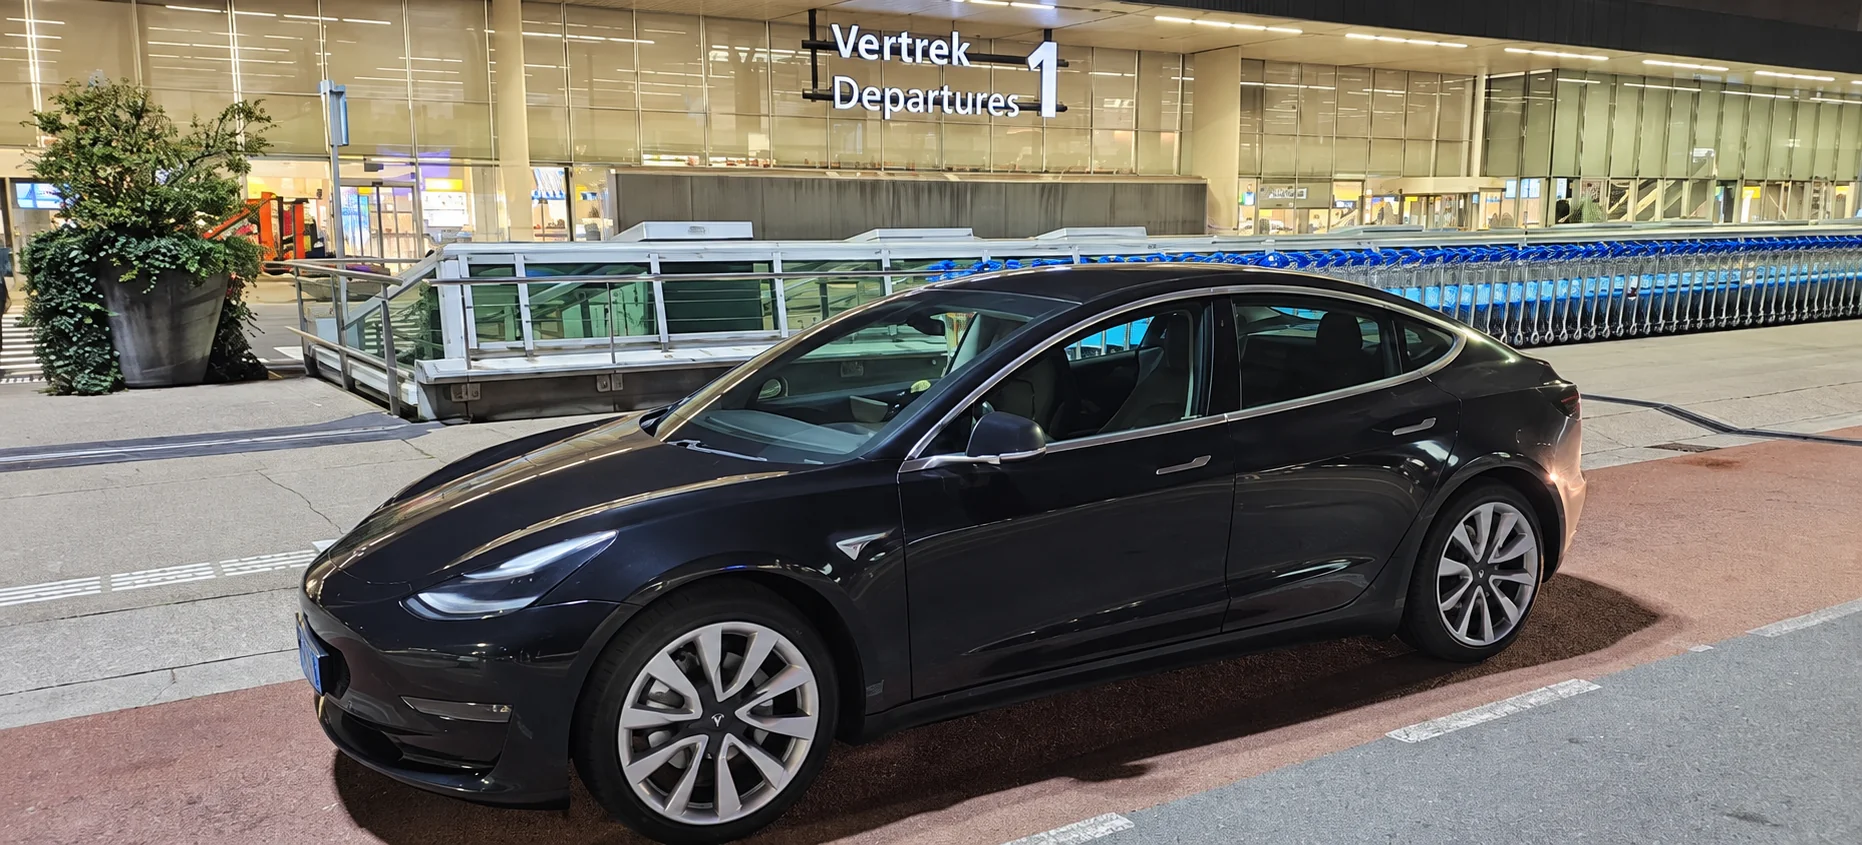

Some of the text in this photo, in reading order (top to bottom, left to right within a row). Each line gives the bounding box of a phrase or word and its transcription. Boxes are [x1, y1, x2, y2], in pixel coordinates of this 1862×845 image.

[831, 23, 971, 67] Vertrek
[833, 75, 1020, 120] Departures
[1027, 41, 1058, 118] 1
